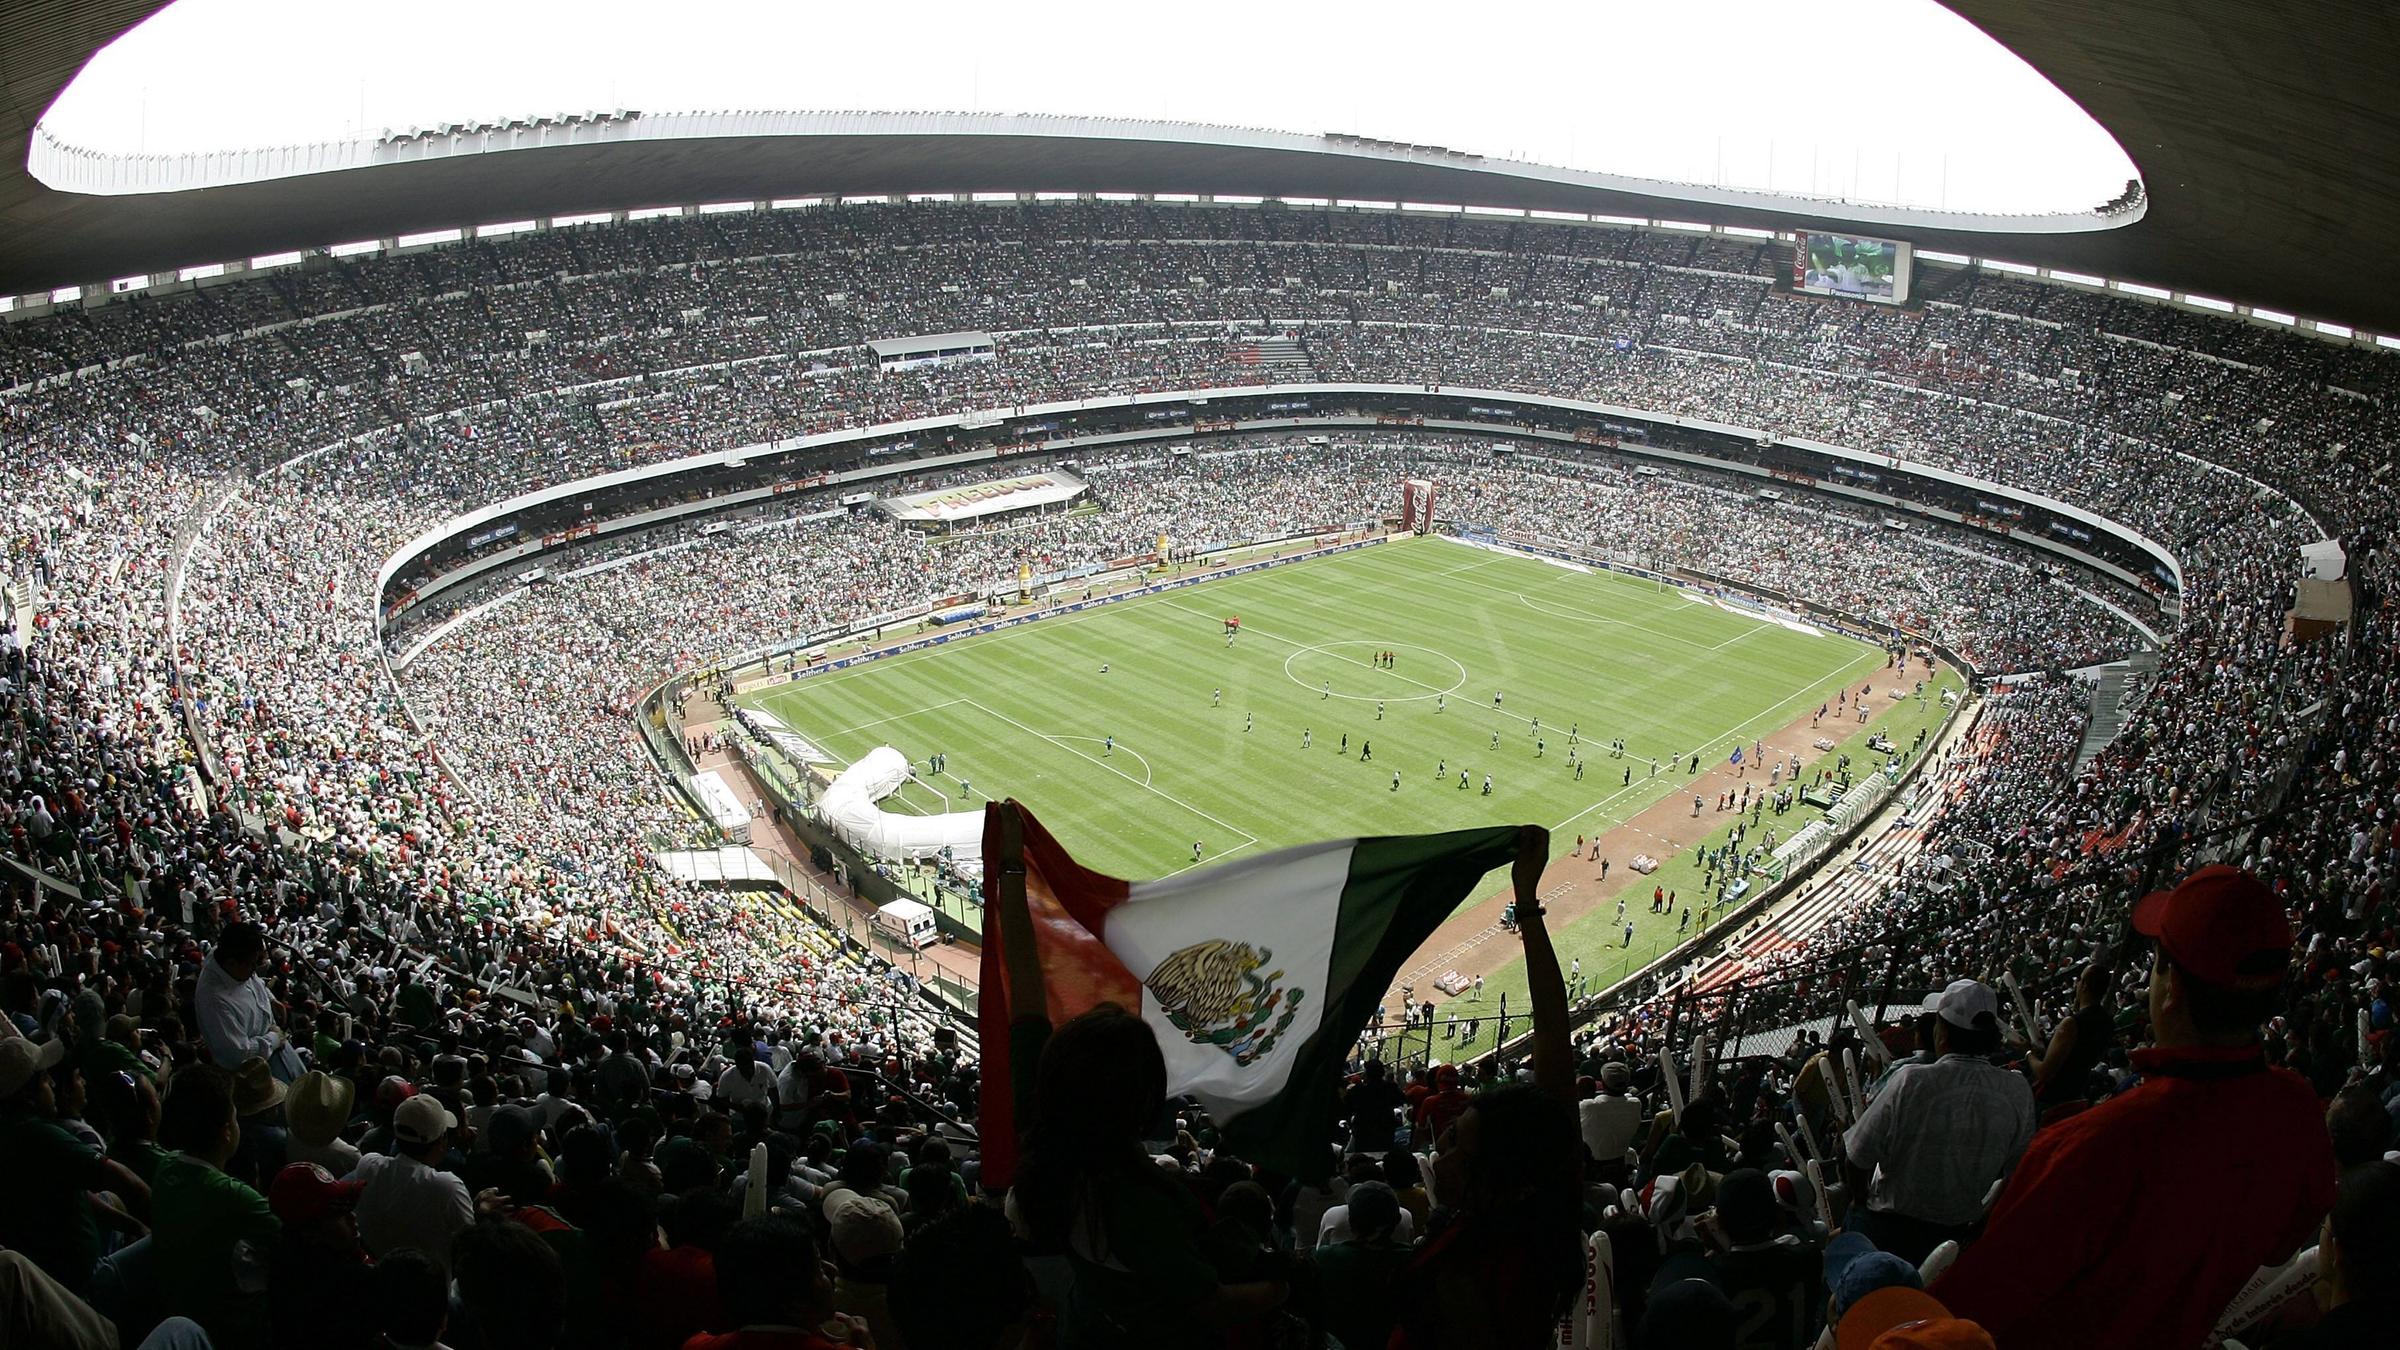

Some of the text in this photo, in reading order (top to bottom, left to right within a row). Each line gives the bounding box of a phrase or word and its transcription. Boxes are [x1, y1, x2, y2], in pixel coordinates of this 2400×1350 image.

[1794, 237, 1806, 269] Coca-Cola
[1830, 288, 1866, 300] Panasonic
[912, 474, 1057, 518] FREEDOM
[1411, 487, 1428, 534] Coca-Cola
[471, 525, 515, 546] Corona Corona
[772, 635, 808, 654] PHILIPS
[796, 665, 825, 680] Selther
[1733, 1282, 1806, 1349] 21
[2231, 1315, 2247, 1330] de
[2285, 1271, 2318, 1296] desde
